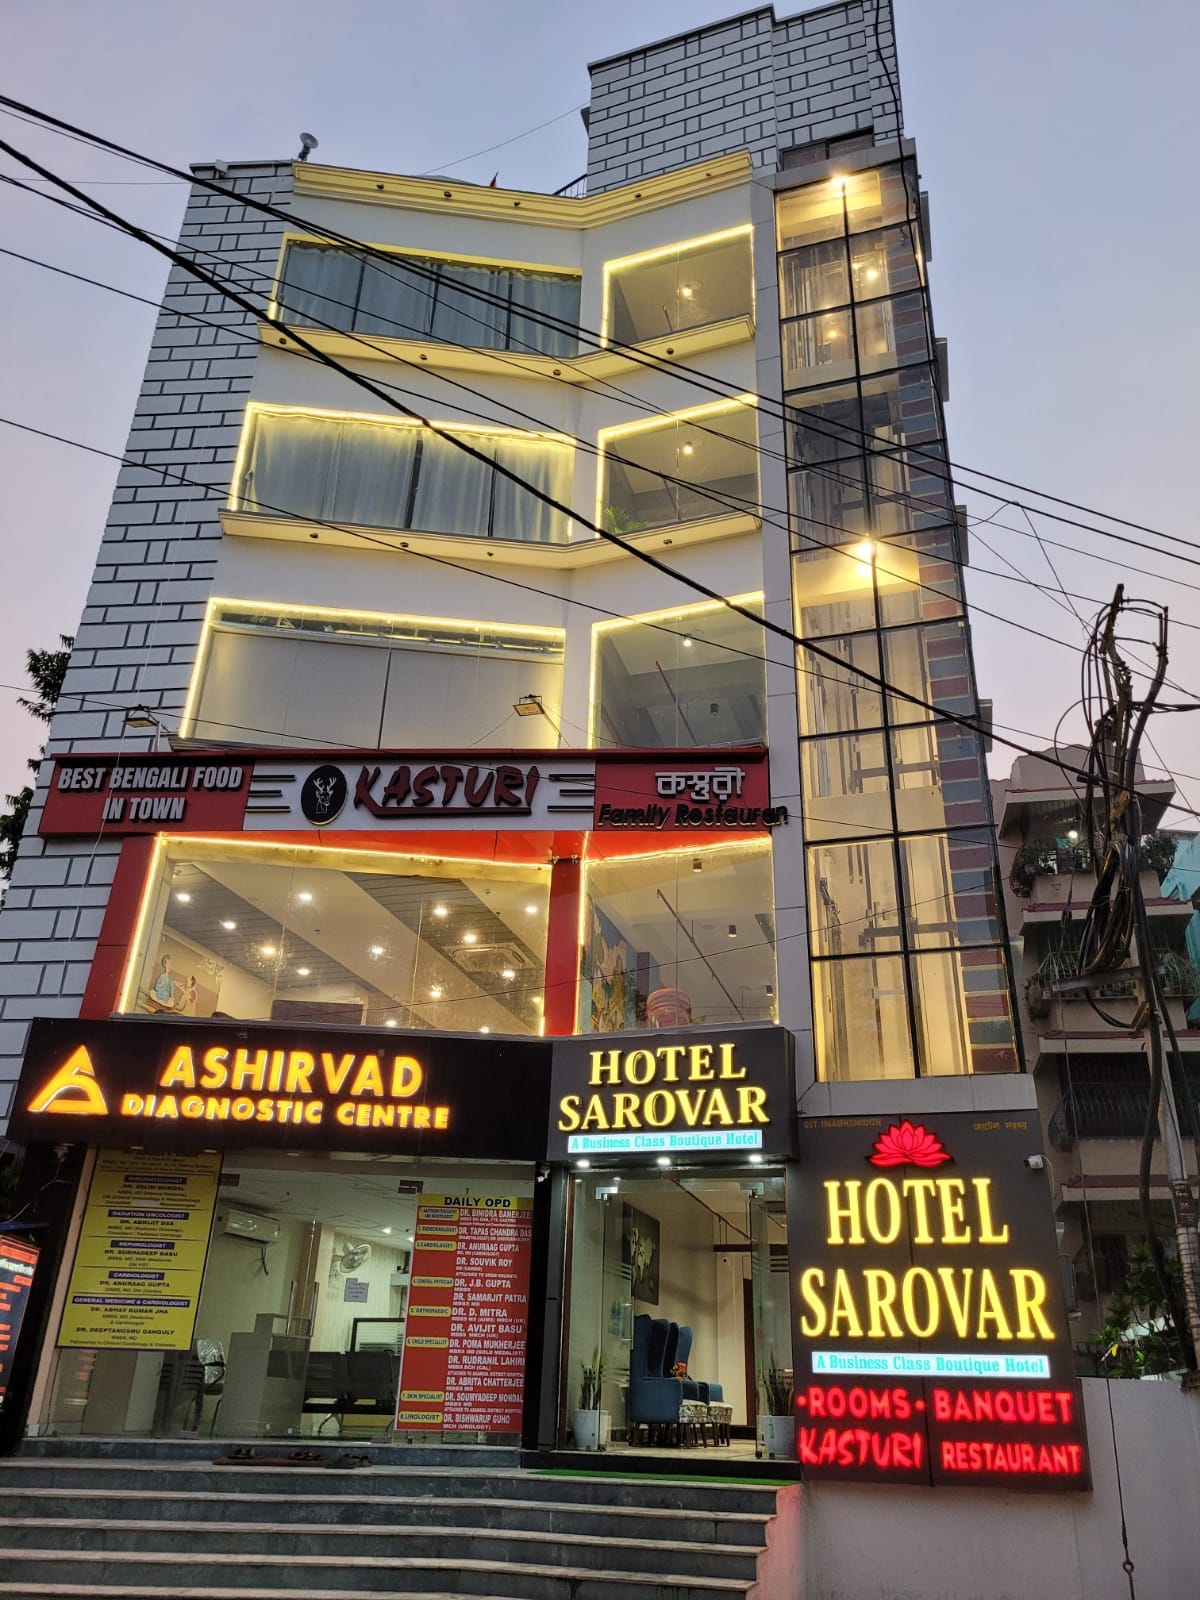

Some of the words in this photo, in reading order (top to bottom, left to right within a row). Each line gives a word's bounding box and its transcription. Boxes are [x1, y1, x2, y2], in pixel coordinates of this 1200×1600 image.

[58, 767, 106, 789] BEST
[109, 767, 189, 789] BENGALI
[192, 766, 243, 789] FOOD
[353, 765, 540, 815] KASTURI
[103, 797, 125, 820] IN
[129, 797, 185, 820] TOWN
[598, 803, 672, 830] Family
[160, 1045, 423, 1097] ASHIRVAD
[588, 1043, 746, 1085] HOTEL
[121, 1093, 322, 1124] DIAGNOSTIC
[337, 1102, 450, 1129] CENTRE
[558, 1086, 770, 1132] SAROVAR
[572, 1138, 579, 1149] A
[582, 1136, 630, 1149] Business
[635, 1135, 665, 1147] Class
[669, 1133, 721, 1148] Boutique
[726, 1132, 758, 1145] Hotel
[444, 1196, 480, 1206] DAILY
[485, 1198, 511, 1208] OPD
[823, 1177, 1009, 1245] HOTEL
[470, 1227, 488, 1236] TAPAS
[490, 1228, 518, 1237] CHANDRA
[458, 1242, 467, 1250] DR.
[469, 1242, 498, 1251] ANURAAG
[500, 1244, 520, 1252] GUPTA
[470, 1258, 496, 1266] SOUVIK
[498, 1259, 513, 1268] ROY
[454, 1279, 467, 1287] DR.
[470, 1280, 484, 1288] J.B.
[486, 1280, 512, 1288] GUPTA
[454, 1292, 465, 1300] DR.
[467, 1293, 502, 1302] SAMARJIT
[504, 1294, 527, 1303] PATRA
[801, 1267, 1055, 1340] SAROVAR
[452, 1308, 466, 1316] DR.
[469, 1308, 478, 1316] D.
[480, 1308, 507, 1318] MITRA
[451, 1324, 465, 1332] DR.
[468, 1324, 496, 1333] AVIJIT
[498, 1324, 522, 1334] BASU
[450, 1339, 460, 1348] DR.
[484, 1340, 526, 1350] MUKHERJEE
[448, 1356, 460, 1364] DR.
[462, 1356, 499, 1365] RUDRANIL
[500, 1357, 525, 1366] LAHIRI
[816, 1356, 825, 1369] A
[829, 1355, 888, 1370] Business
[893, 1356, 931, 1371] Class
[936, 1357, 1000, 1375] Boutique
[1004, 1357, 1044, 1373] Hotel
[446, 1377, 456, 1385] DR.
[458, 1378, 482, 1386] ABRITA
[483, 1378, 524, 1387] CHATTERJEE
[446, 1392, 455, 1400] DR.
[498, 1394, 524, 1402] MONDAL
[933, 1389, 1073, 1424] BANQUET
[444, 1414, 454, 1422] DR.
[799, 1427, 924, 1469] KASTURI
[942, 1441, 1081, 1474] RESTAURANT
